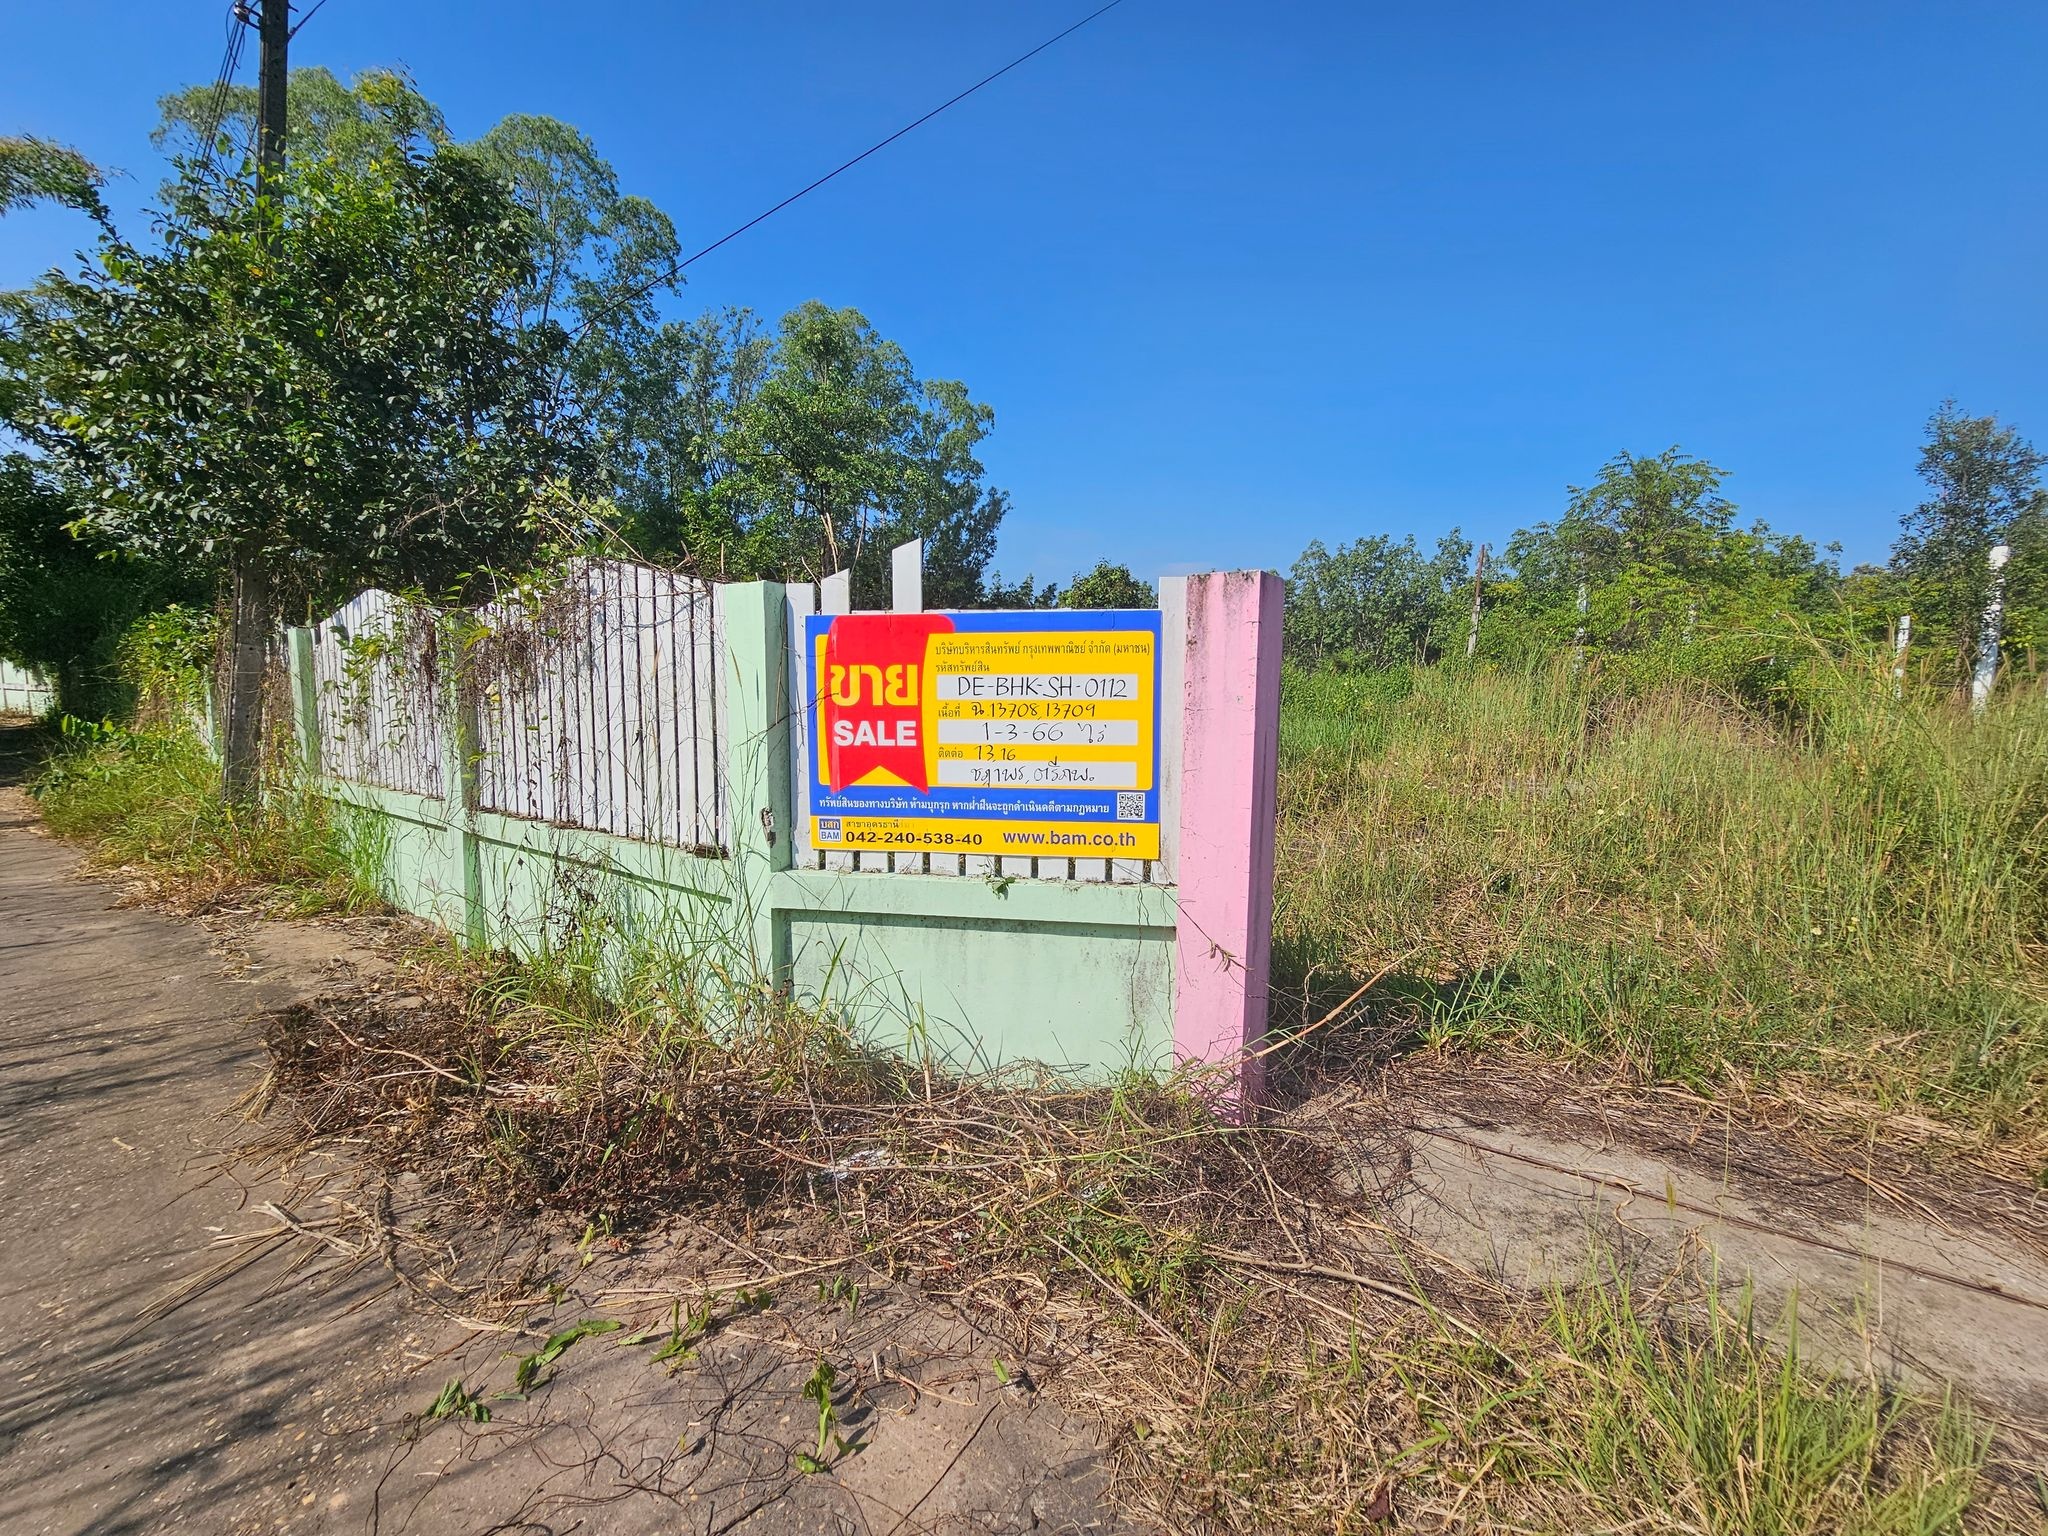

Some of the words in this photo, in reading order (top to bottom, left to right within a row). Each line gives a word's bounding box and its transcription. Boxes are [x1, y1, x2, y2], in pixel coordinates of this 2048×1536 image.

[935, 640, 1020, 655] บริษัทบริหารสินทรัพย์
[1023, 640, 1086, 660] กรุงเทพพาณิชย์
[1088, 640, 1111, 654] จำกัด
[1113, 642, 1150, 656] (มหาชน)
[935, 660, 990, 673] รหัสทรัพย์สิน
[830, 664, 918, 707] ขาย
[938, 702, 961, 718] เนื้อที่
[833, 720, 917, 747] SALE
[938, 746, 964, 759] ติดต่อ
[819, 796, 908, 810] ทรัพย์สินของทางบริษัท
[910, 797, 951, 814] ห้ามบุกรุก
[821, 831, 840, 841] BAM
[845, 831, 983, 846] 042-240-538-40
[1002, 830, 1136, 847] www.bam.co.th
